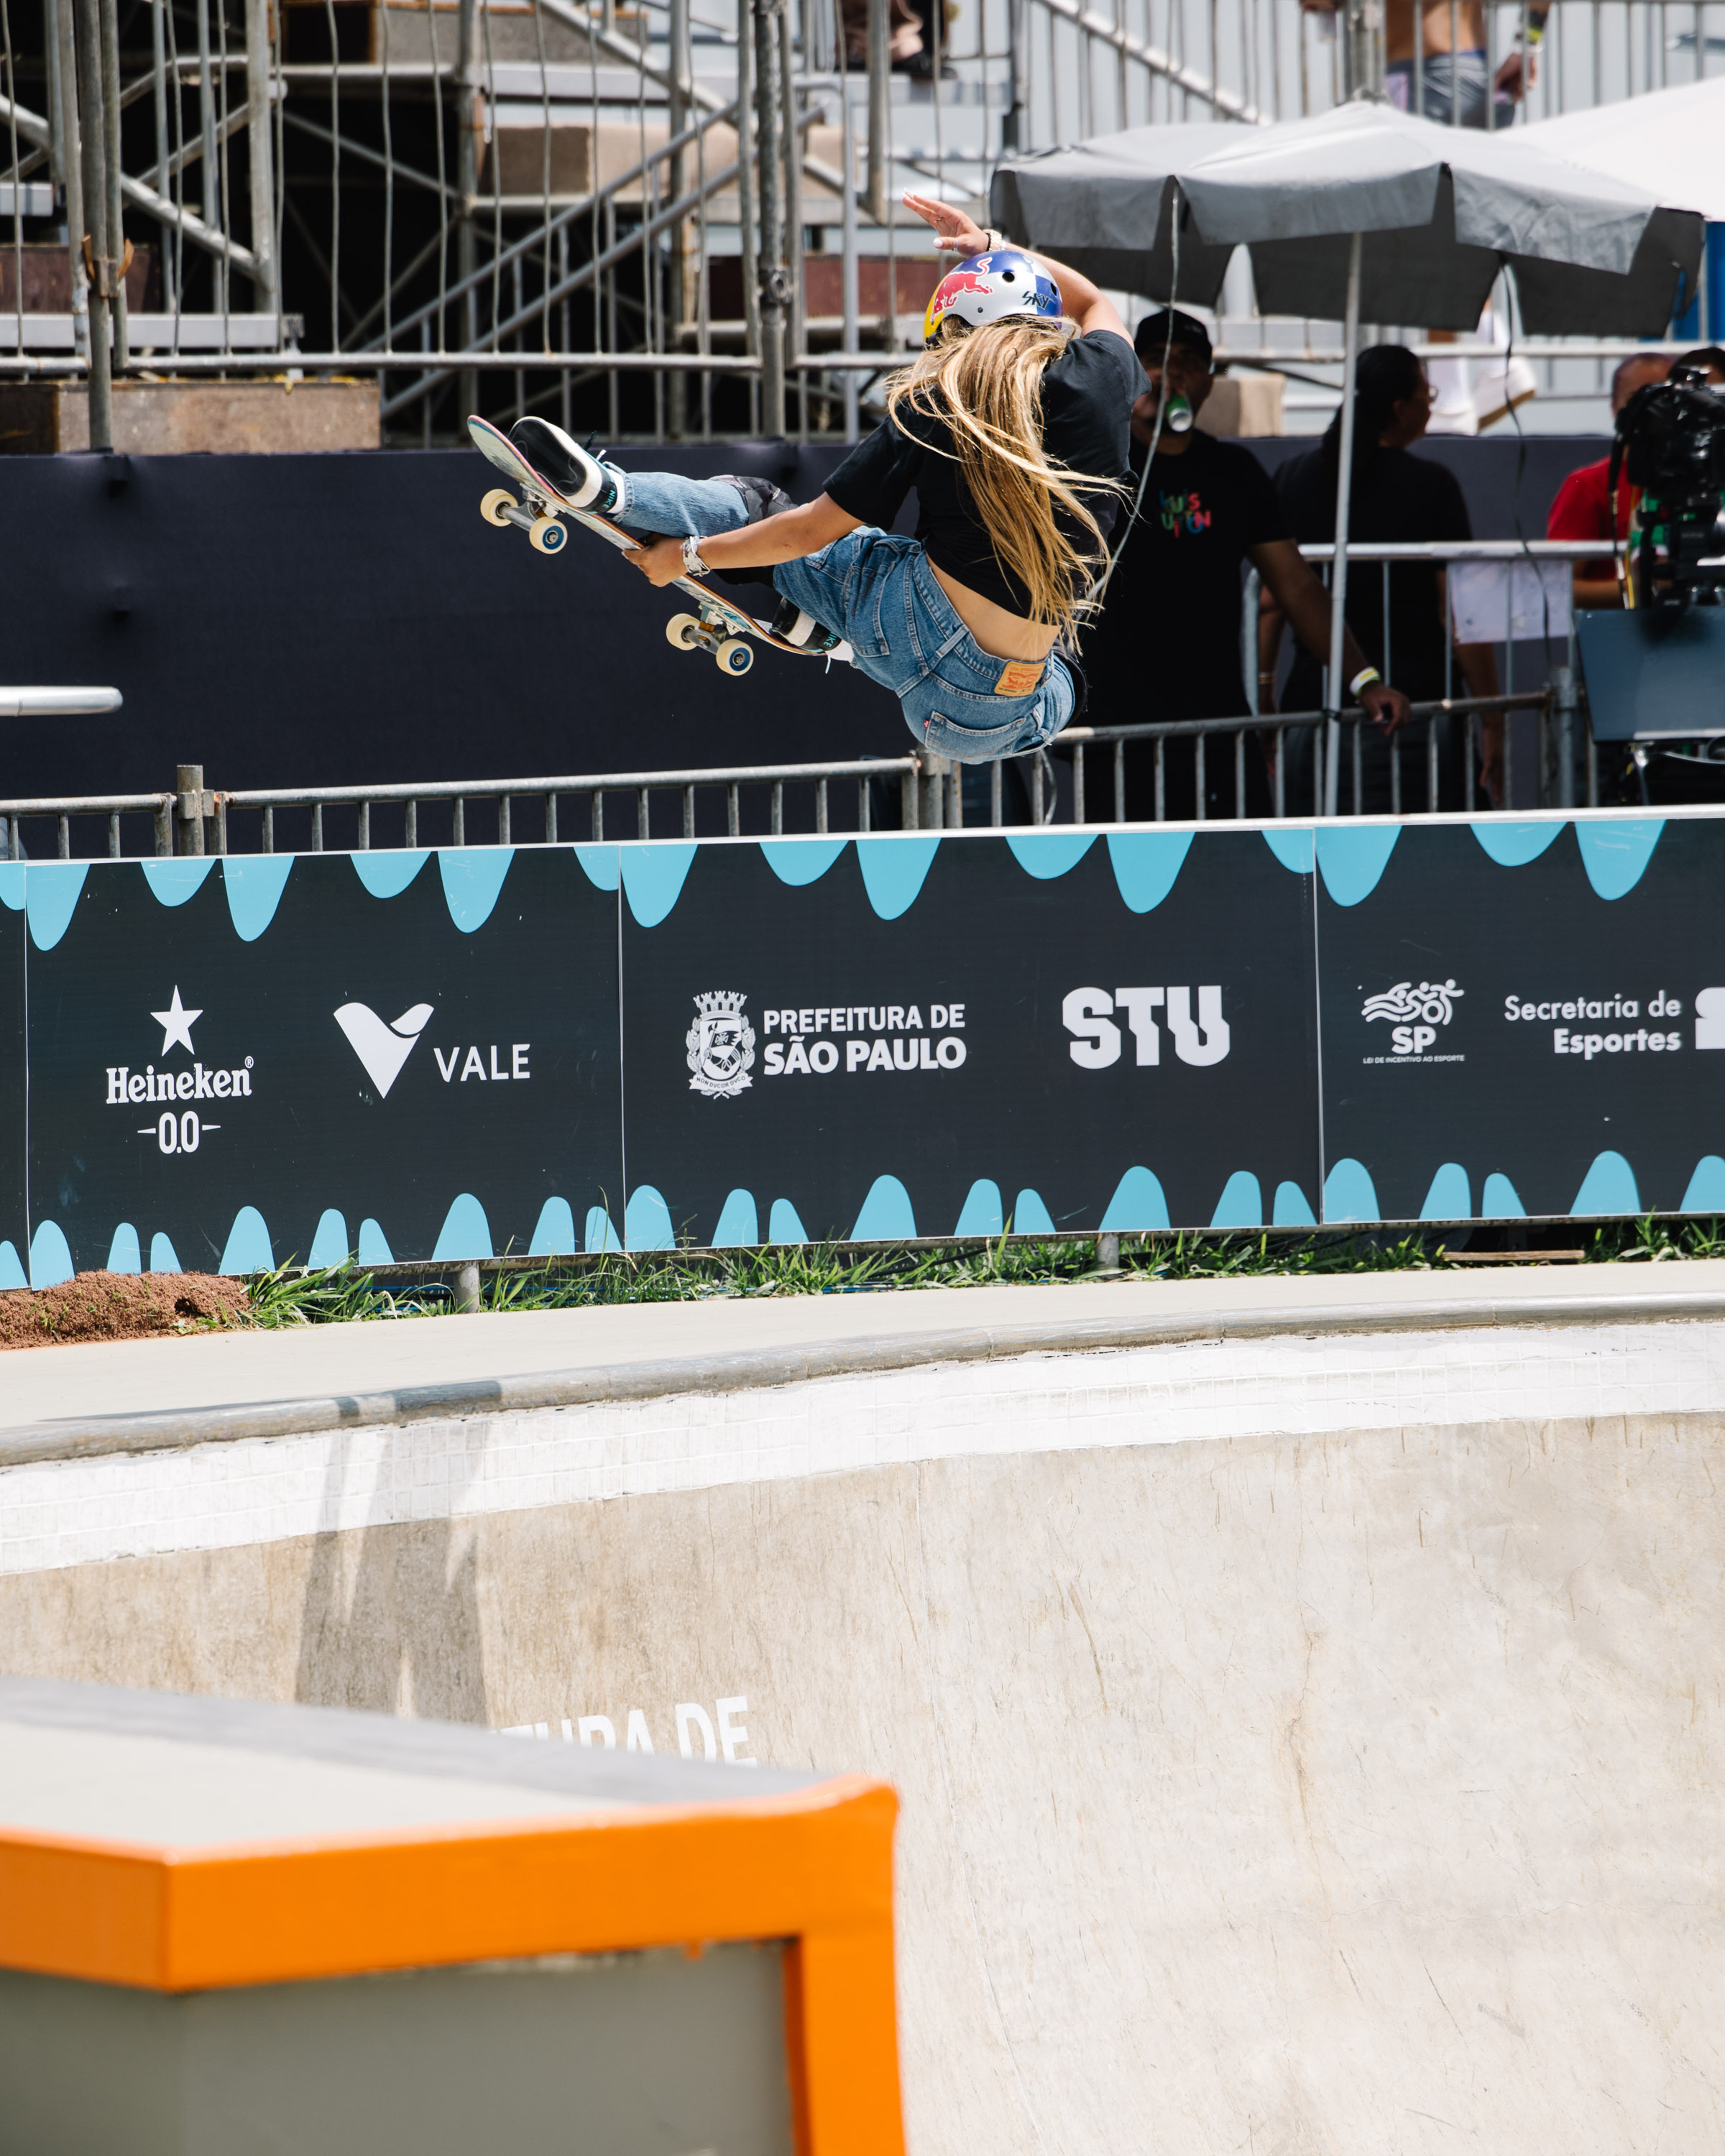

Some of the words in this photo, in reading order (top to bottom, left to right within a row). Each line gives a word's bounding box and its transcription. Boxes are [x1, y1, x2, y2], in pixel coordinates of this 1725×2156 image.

[1021, 290, 1050, 310] SKY
[603, 490, 616, 508] NIKE
[764, 1005, 924, 1034] PREFEITURA
[931, 1004, 965, 1029] DE
[1504, 993, 1639, 1021] Secretaria
[1648, 990, 1682, 1017] de
[1062, 985, 1230, 1069] STU
[1392, 1026, 1437, 1054] SP
[1554, 1028, 1682, 1061] Esportes
[433, 1044, 530, 1083] VALE
[763, 1035, 839, 1076] SÃO
[847, 1037, 967, 1072] PAULO
[106, 1062, 252, 1105] Heineken
[158, 1111, 199, 1154] 0.0
[675, 1696, 758, 1768] DE
